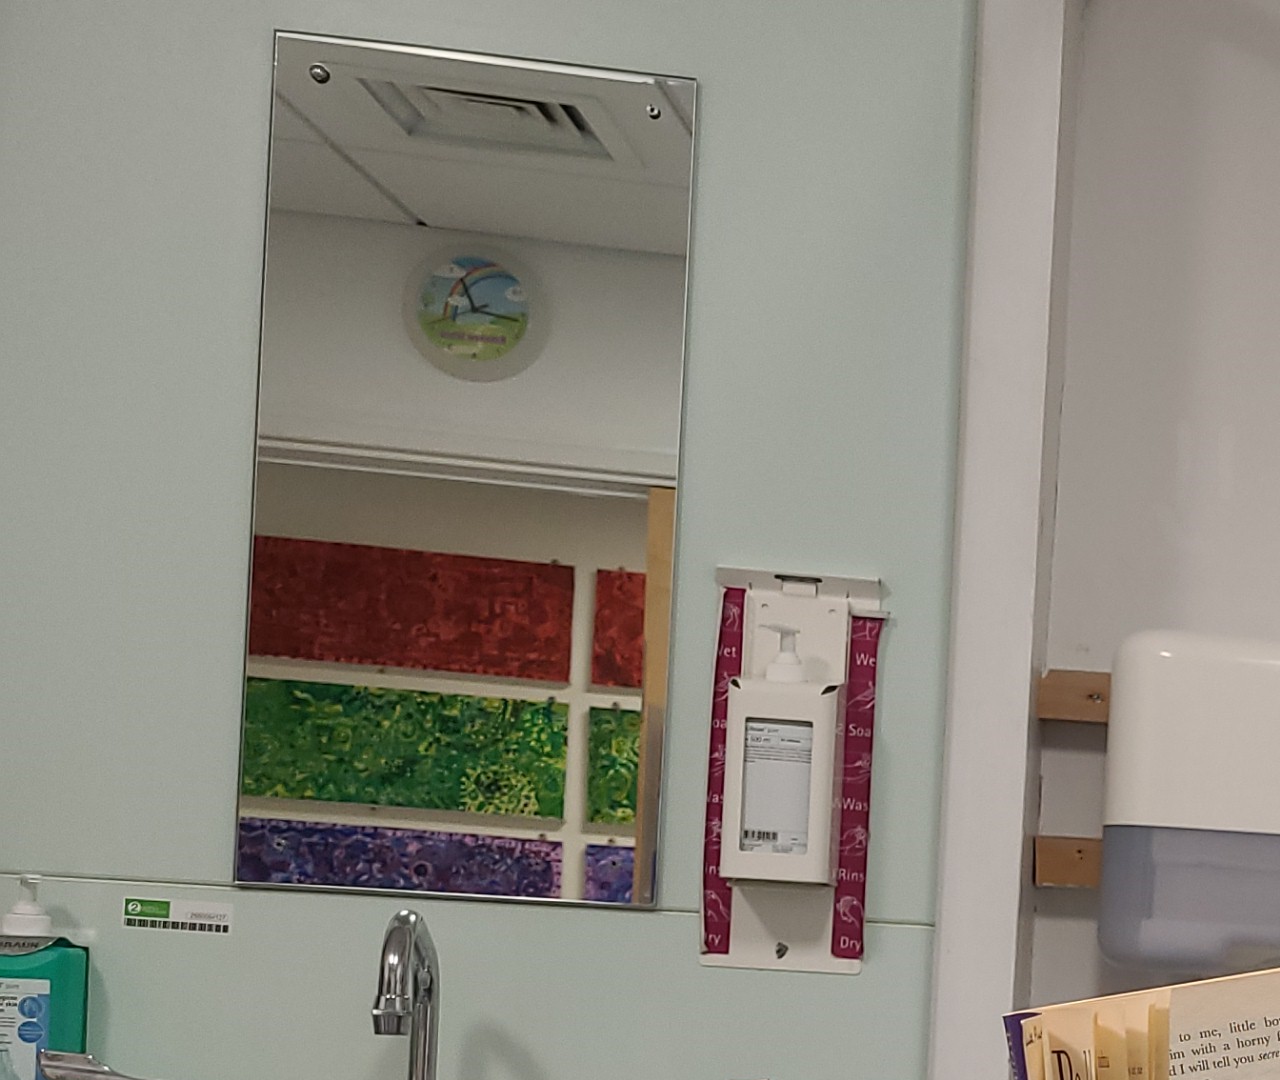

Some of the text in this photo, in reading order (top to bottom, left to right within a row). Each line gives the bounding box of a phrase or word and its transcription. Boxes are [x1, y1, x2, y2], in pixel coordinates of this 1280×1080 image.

[840, 936, 861, 952] Dry
[1178, 1031, 1191, 1042] to
[1199, 1027, 1221, 1041] me,
[1228, 1018, 1256, 1033] little
[1190, 1041, 1216, 1056] with
[1222, 1042, 1230, 1050] a
[1235, 1032, 1271, 1051] horny
[1179, 1063, 1185, 1074] I
[1187, 1059, 1209, 1073] will
[1212, 1055, 1230, 1068] tell
[1233, 1054, 1255, 1068] you
